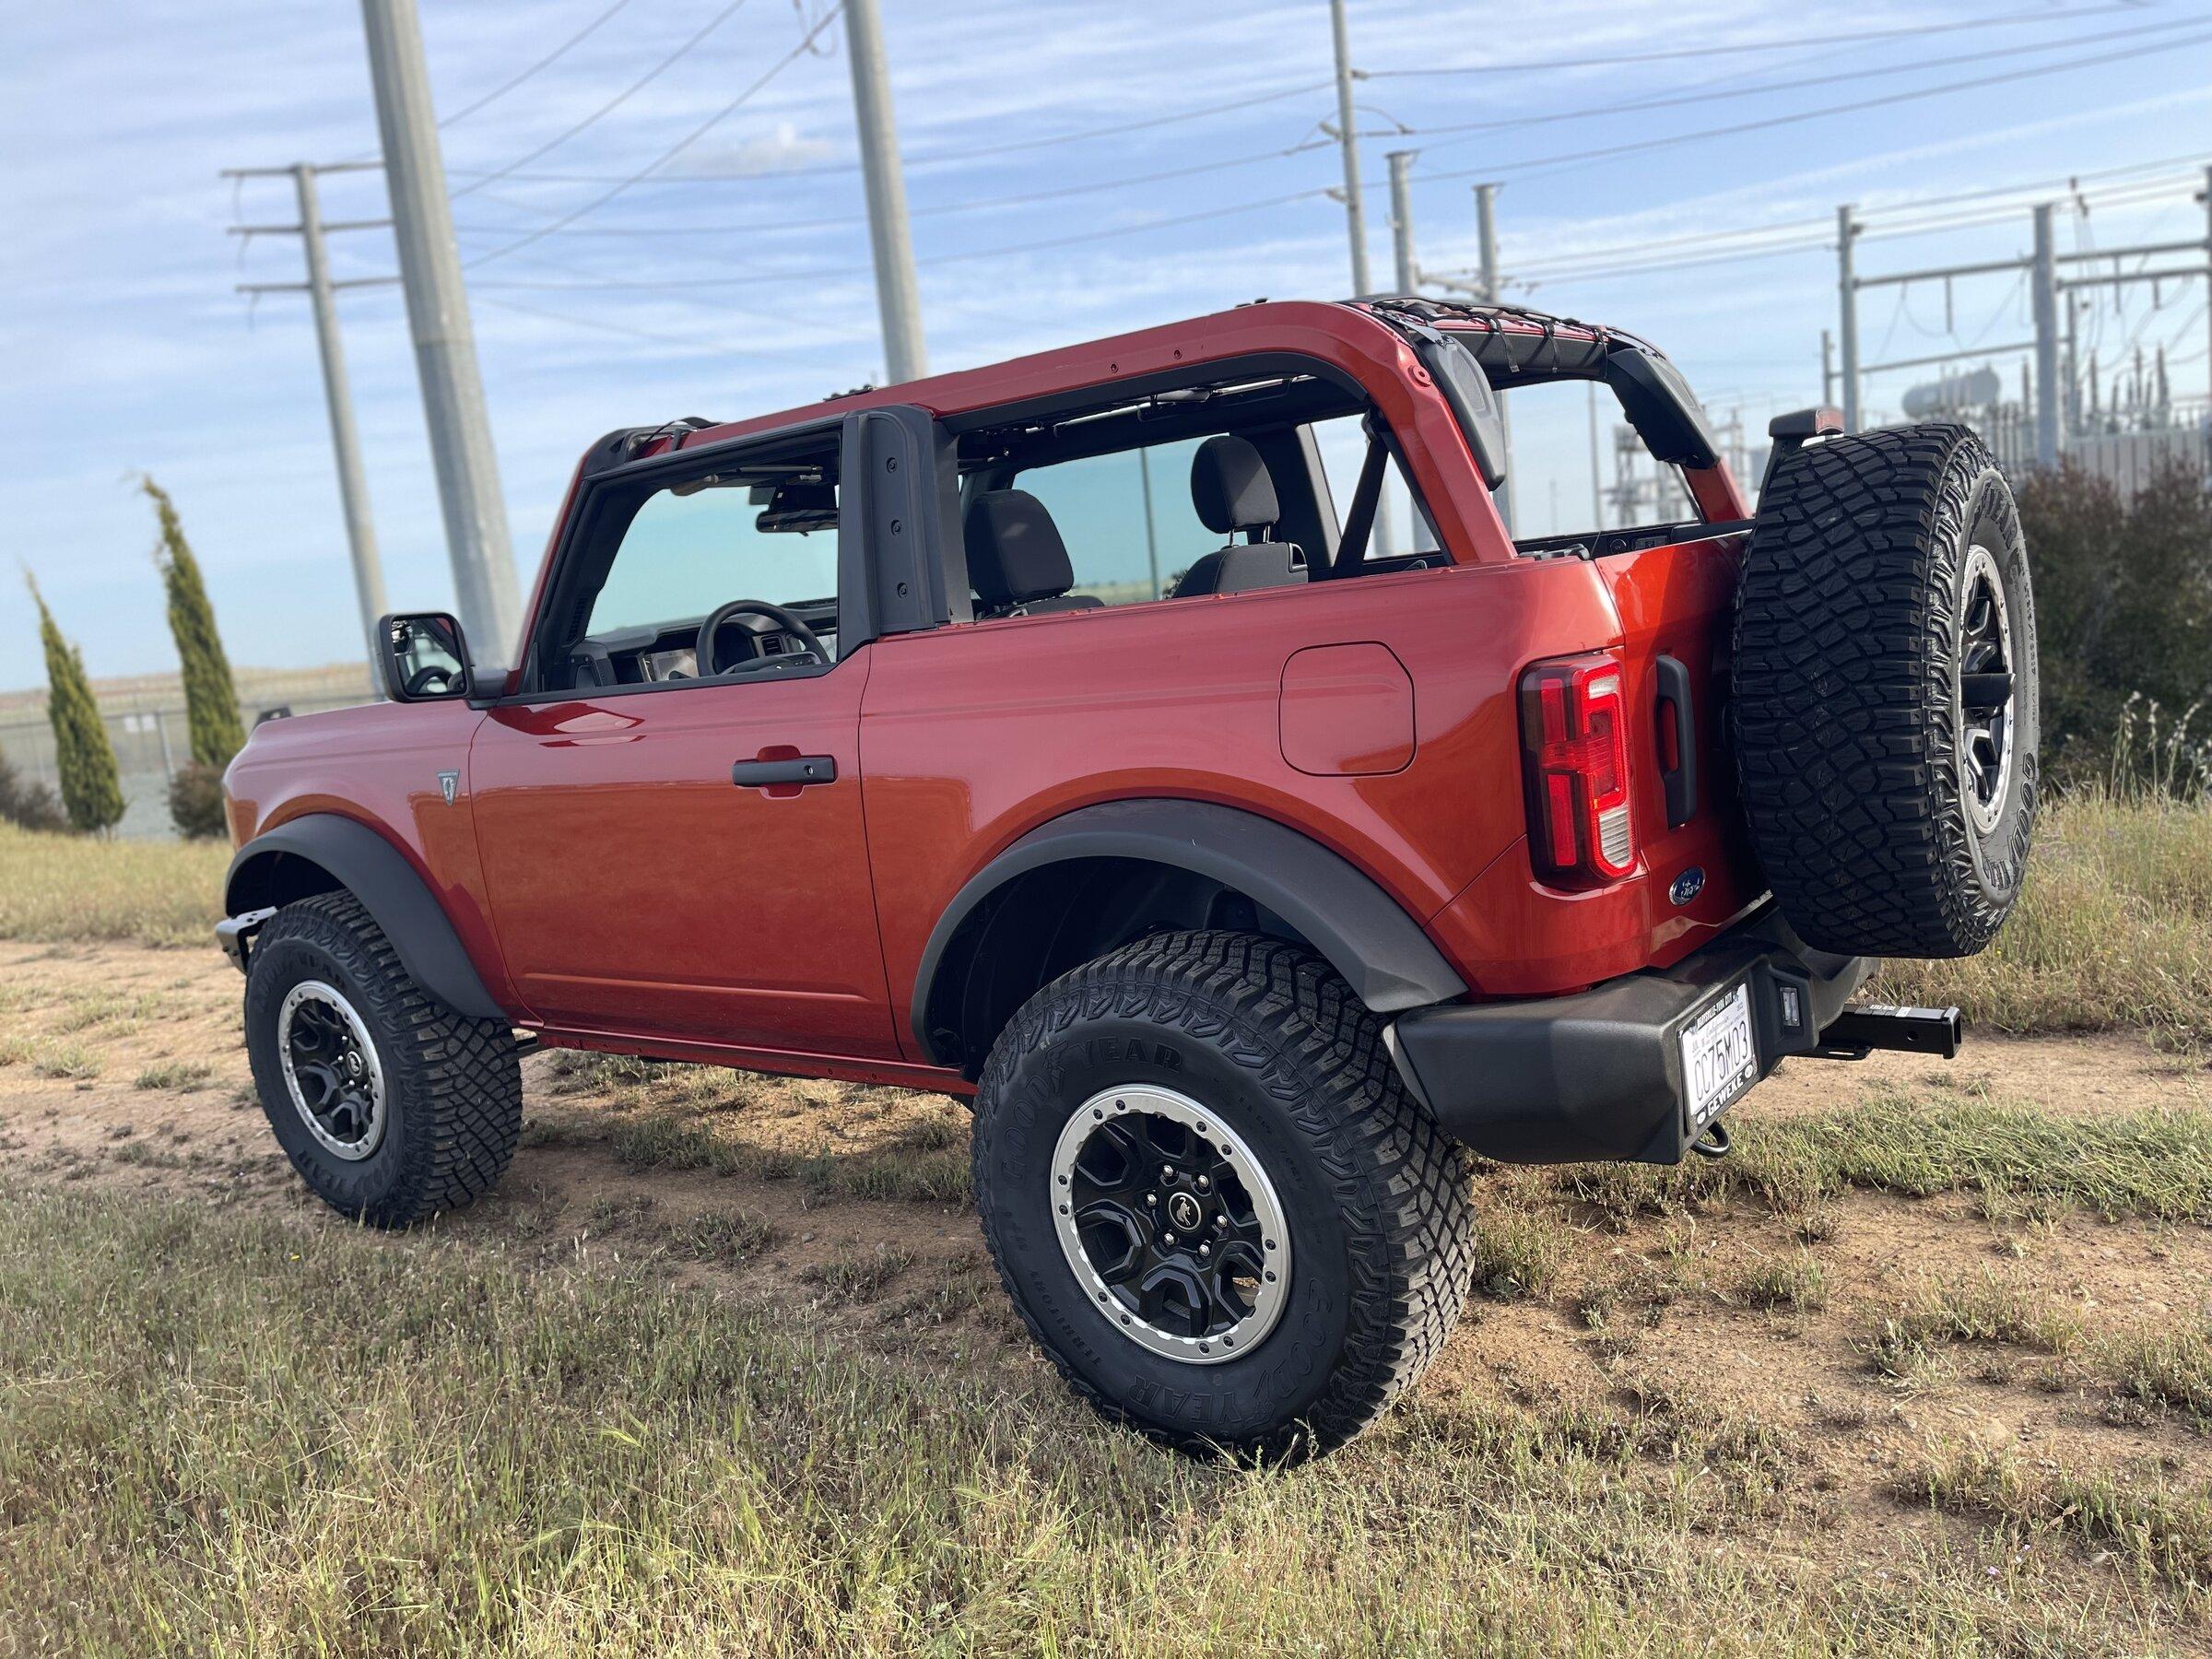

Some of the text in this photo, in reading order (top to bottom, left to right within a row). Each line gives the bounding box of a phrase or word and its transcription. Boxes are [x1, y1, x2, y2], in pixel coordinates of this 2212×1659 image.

[1983, 751, 2037, 891] GOODYEAR
[1000, 1035, 1184, 1189] GOODYEAR
[1693, 1018, 1748, 1101] CC75M03
[1707, 1072, 1745, 1117] GEWEKE
[1126, 1276, 1334, 1432] GOODYEAR
